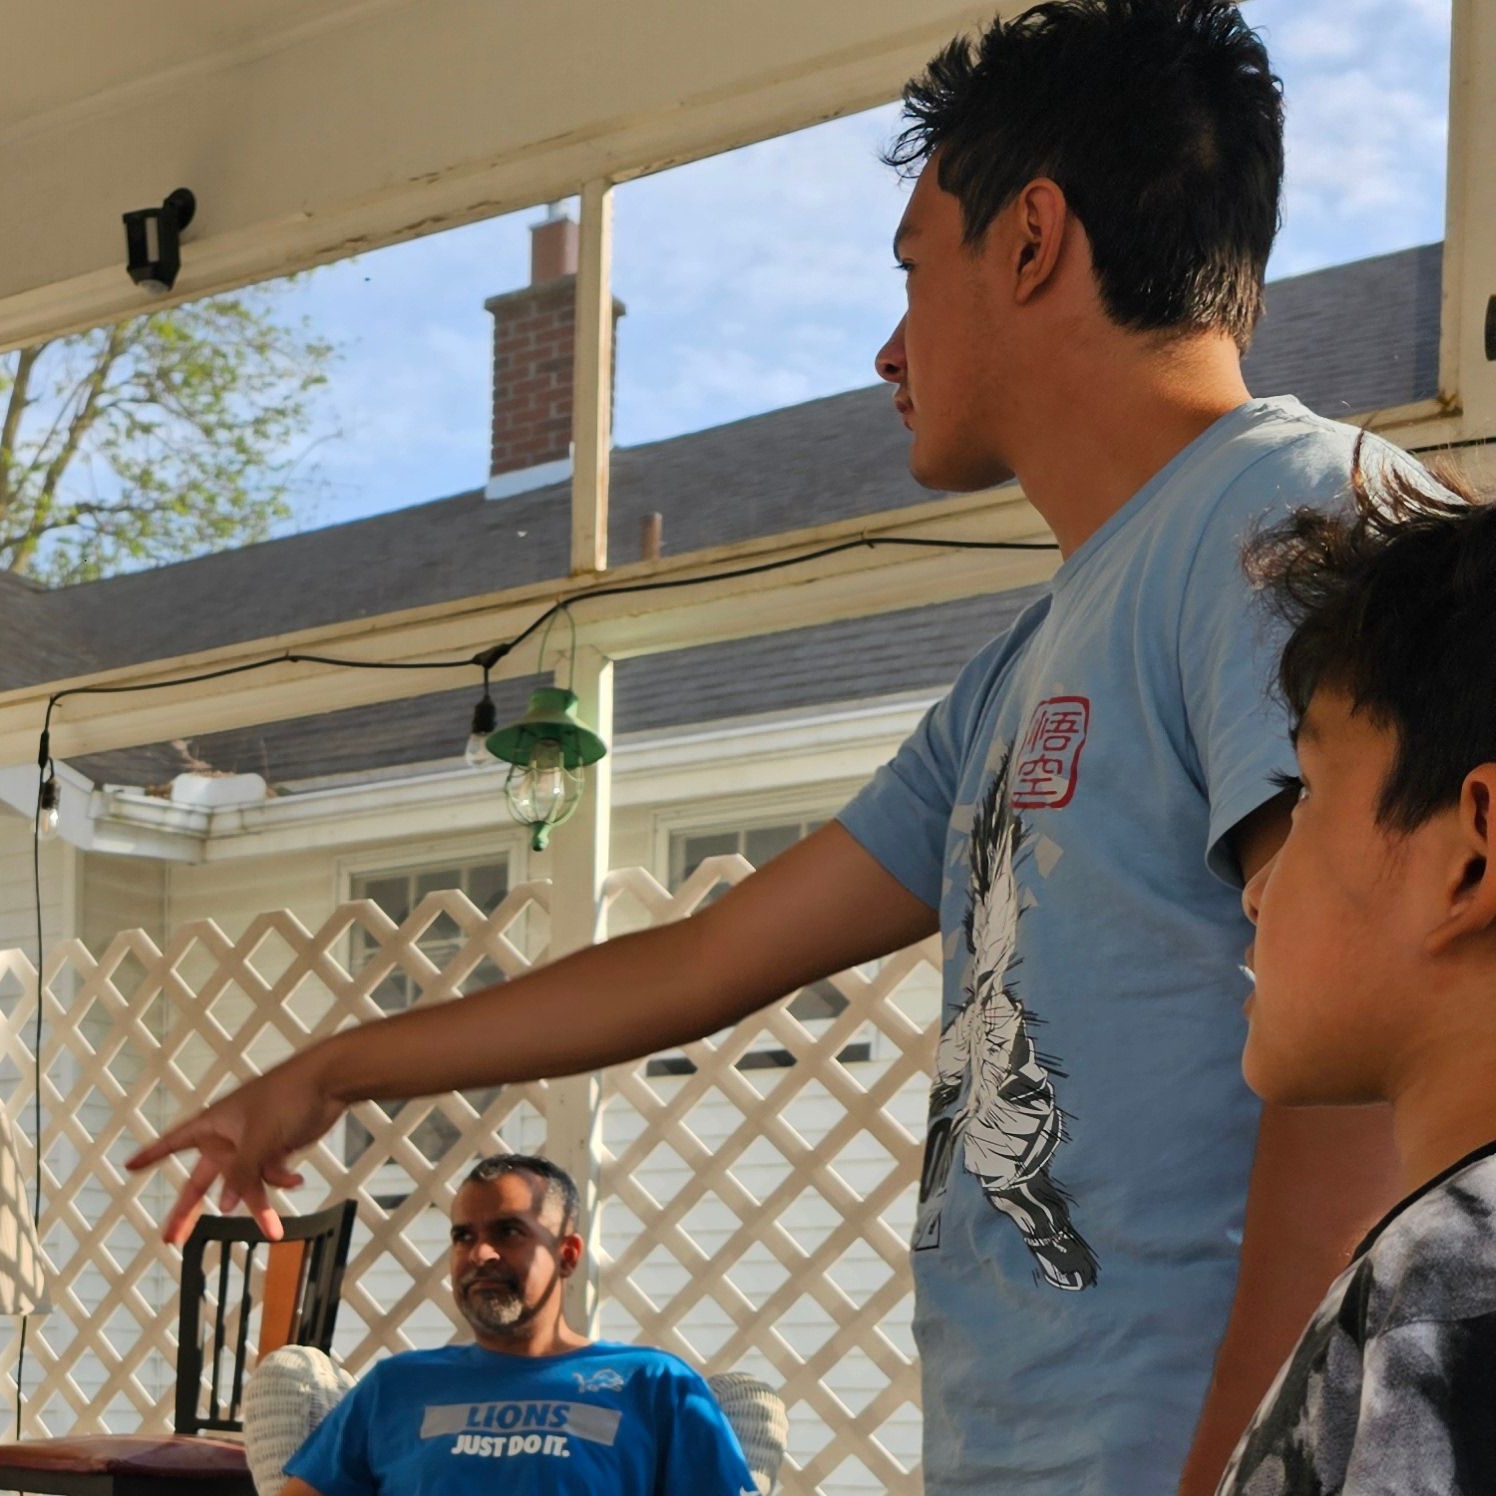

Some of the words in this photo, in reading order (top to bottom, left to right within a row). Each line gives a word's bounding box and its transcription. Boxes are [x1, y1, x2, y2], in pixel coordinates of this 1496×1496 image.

[466, 1402, 571, 1430] LIONS
[451, 1434, 507, 1458] JUST
[507, 1434, 542, 1456] DO
[542, 1435, 571, 1457] IT.
